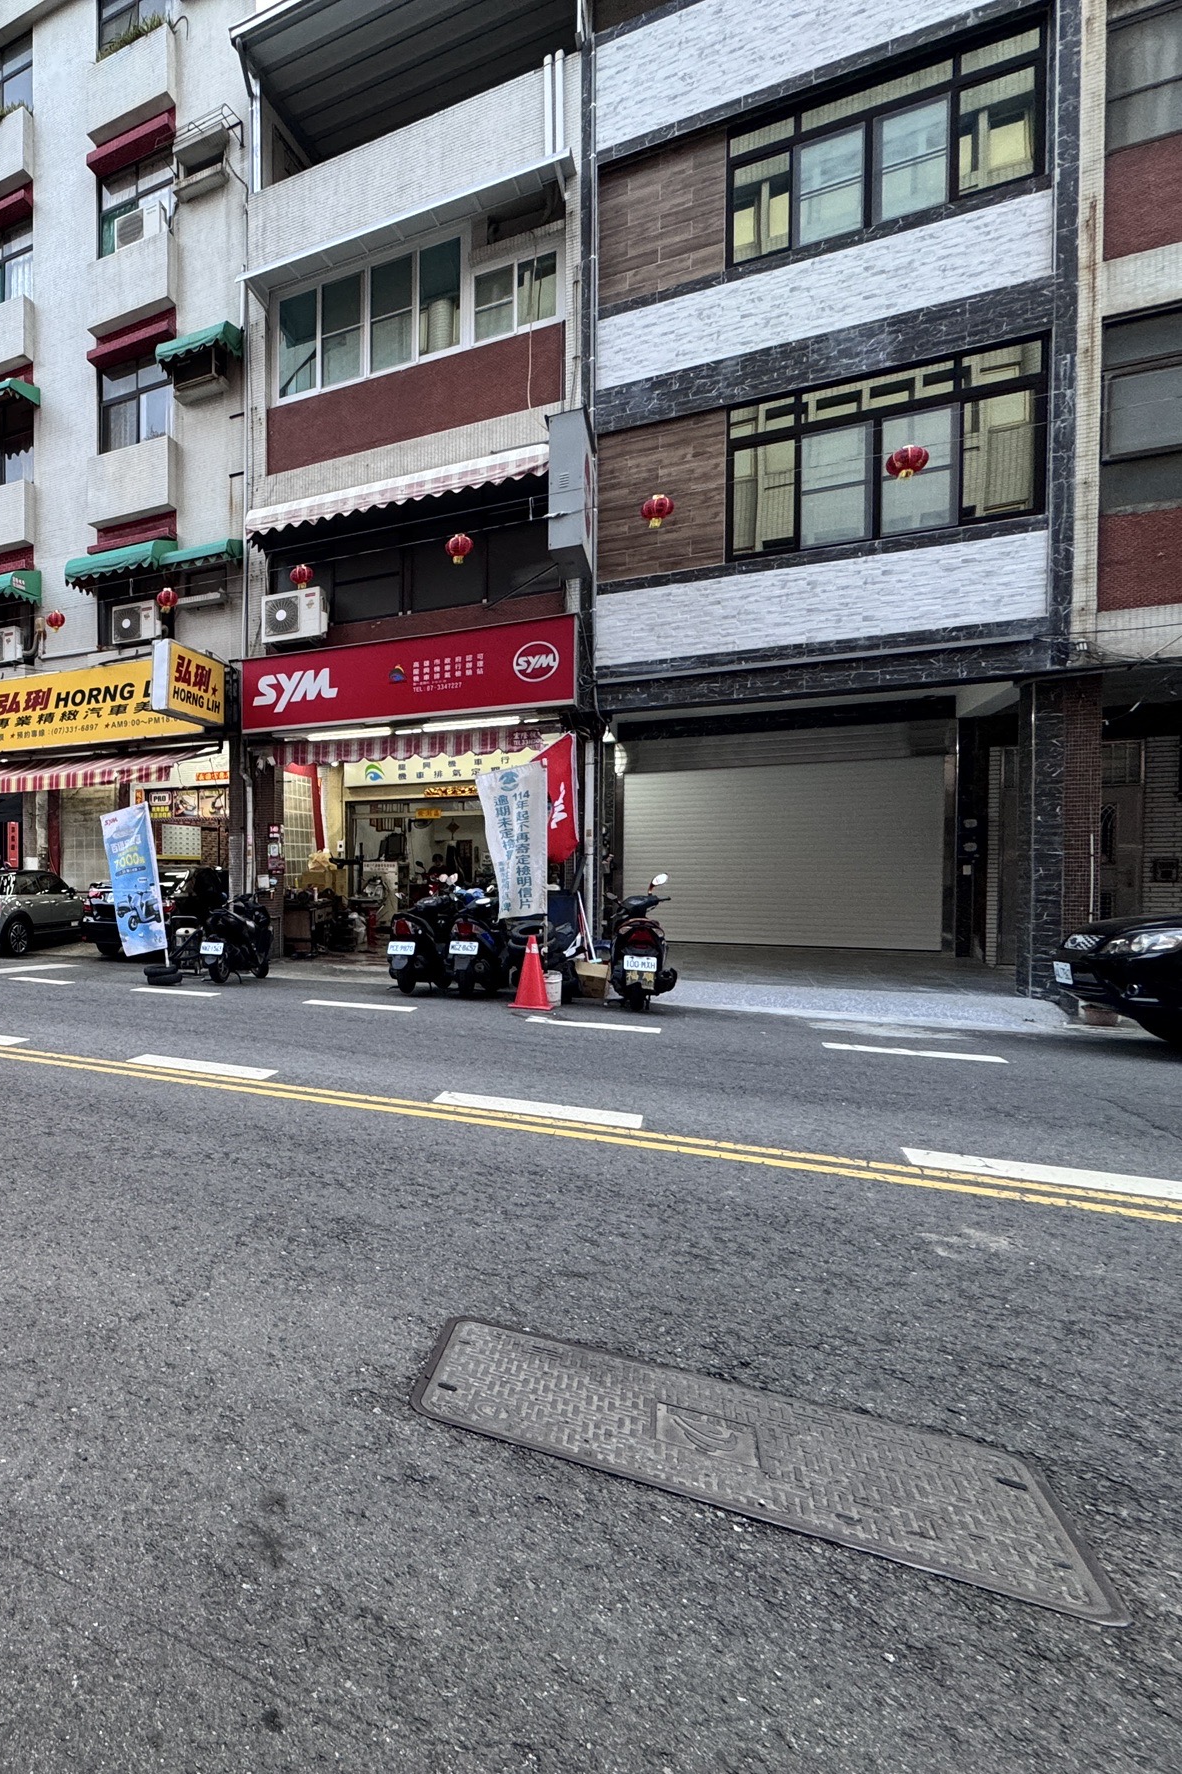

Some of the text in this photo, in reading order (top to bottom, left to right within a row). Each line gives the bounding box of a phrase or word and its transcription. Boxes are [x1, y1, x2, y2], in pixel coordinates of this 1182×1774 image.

[515, 653, 557, 673] SYM
[55, 684, 135, 709] HORNG
[172, 685, 221, 714] HORNG LIH
[252, 667, 339, 713] SYM
